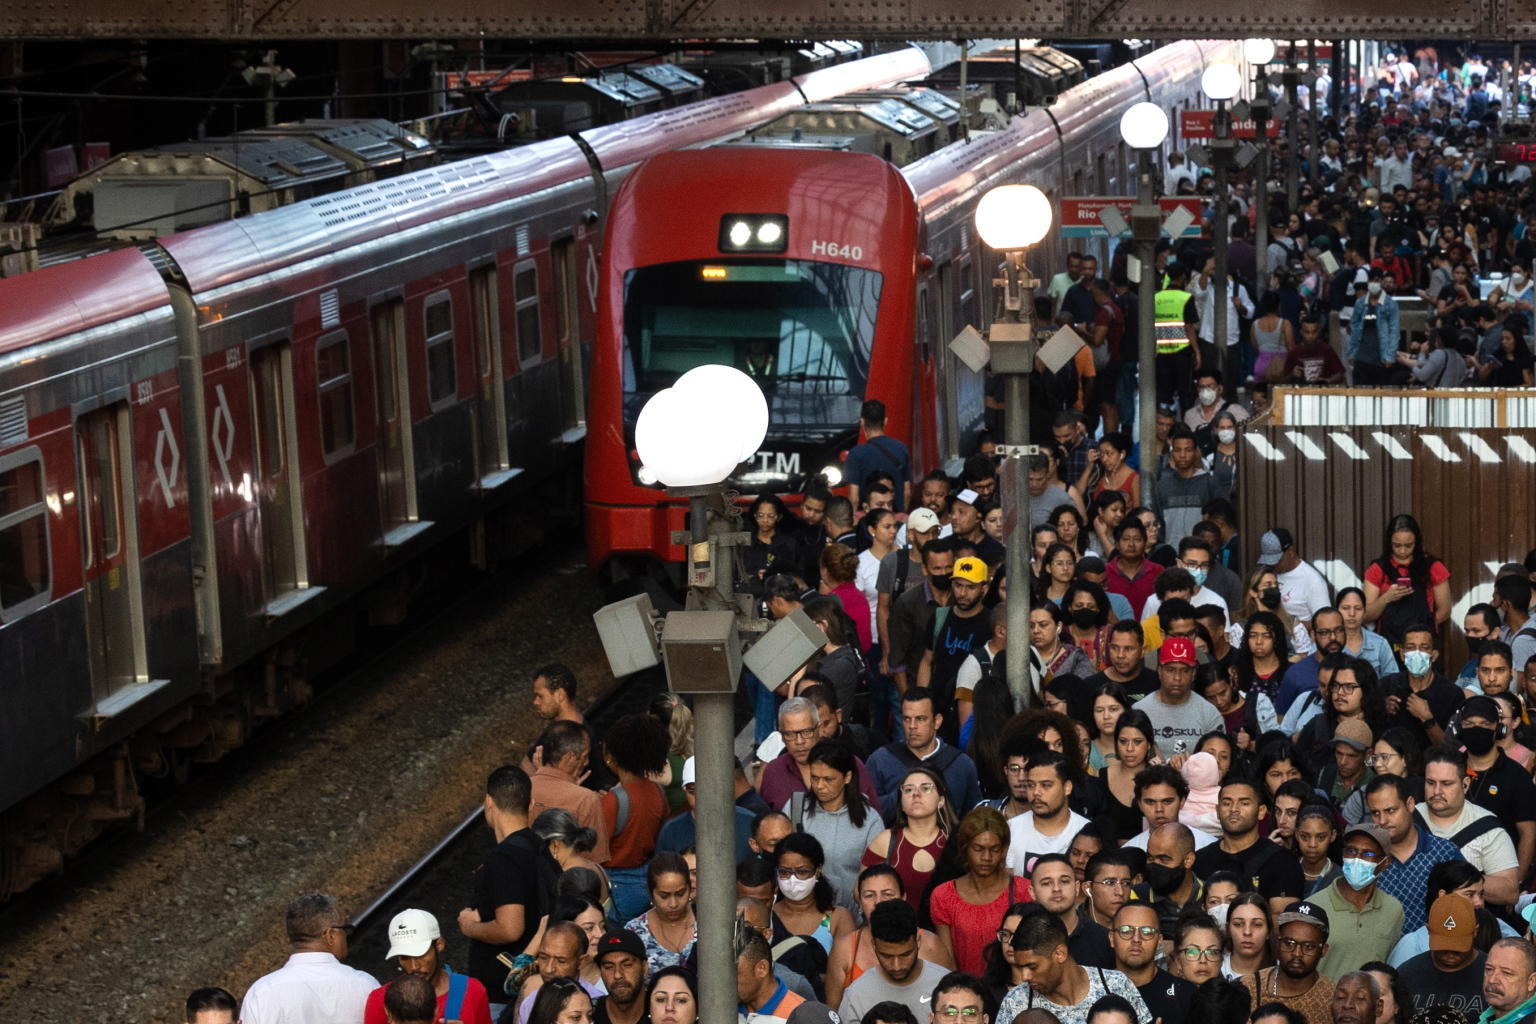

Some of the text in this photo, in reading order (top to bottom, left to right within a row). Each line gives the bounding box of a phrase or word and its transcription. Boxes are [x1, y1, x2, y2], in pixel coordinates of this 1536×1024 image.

[1077, 209, 1096, 219] Rio
[811, 240, 863, 261] H640
[392, 929, 417, 937] LACOSTE
